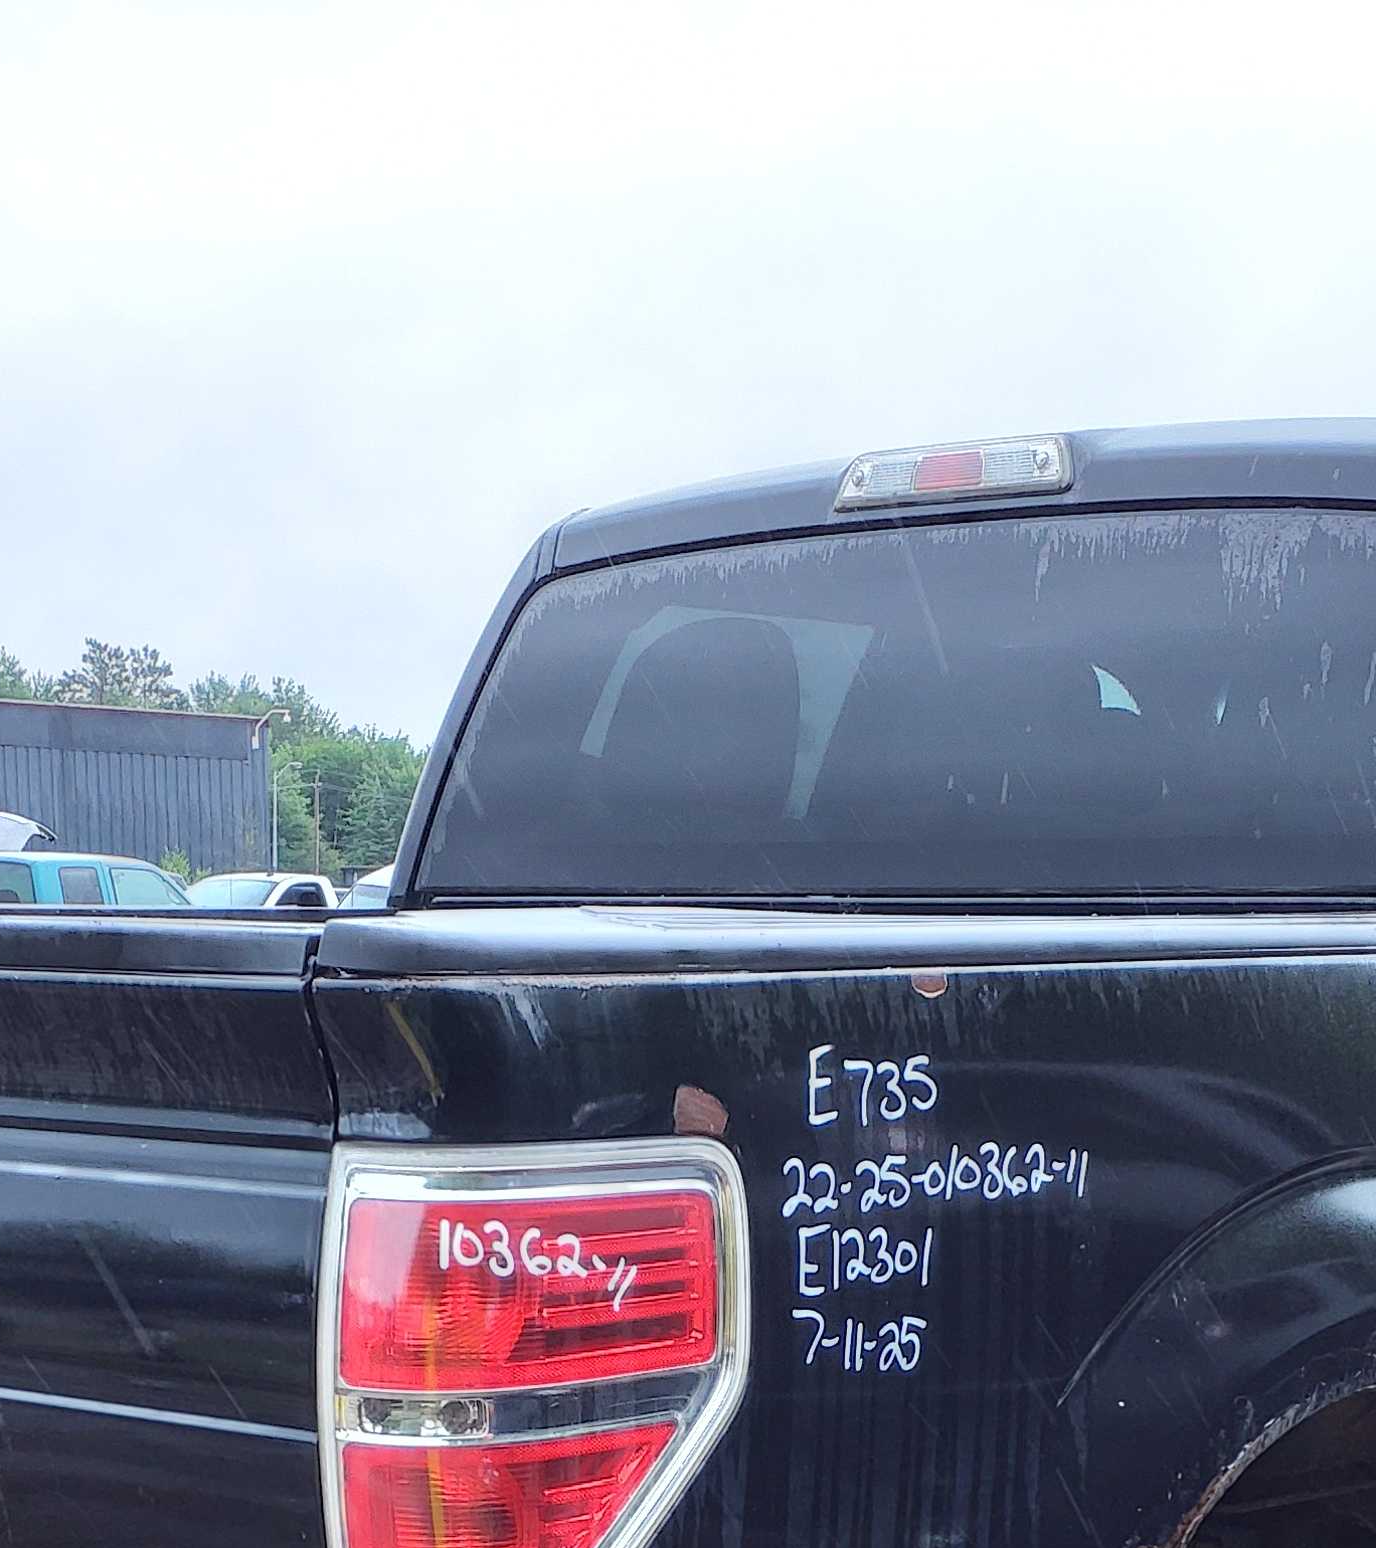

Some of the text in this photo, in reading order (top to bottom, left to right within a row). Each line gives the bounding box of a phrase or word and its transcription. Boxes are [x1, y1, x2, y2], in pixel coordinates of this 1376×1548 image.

[782, 1141, 1089, 1217] 22-25-010362-11
[798, 1223, 934, 1297] E12301
[792, 1308, 928, 1372] 7-11-25
